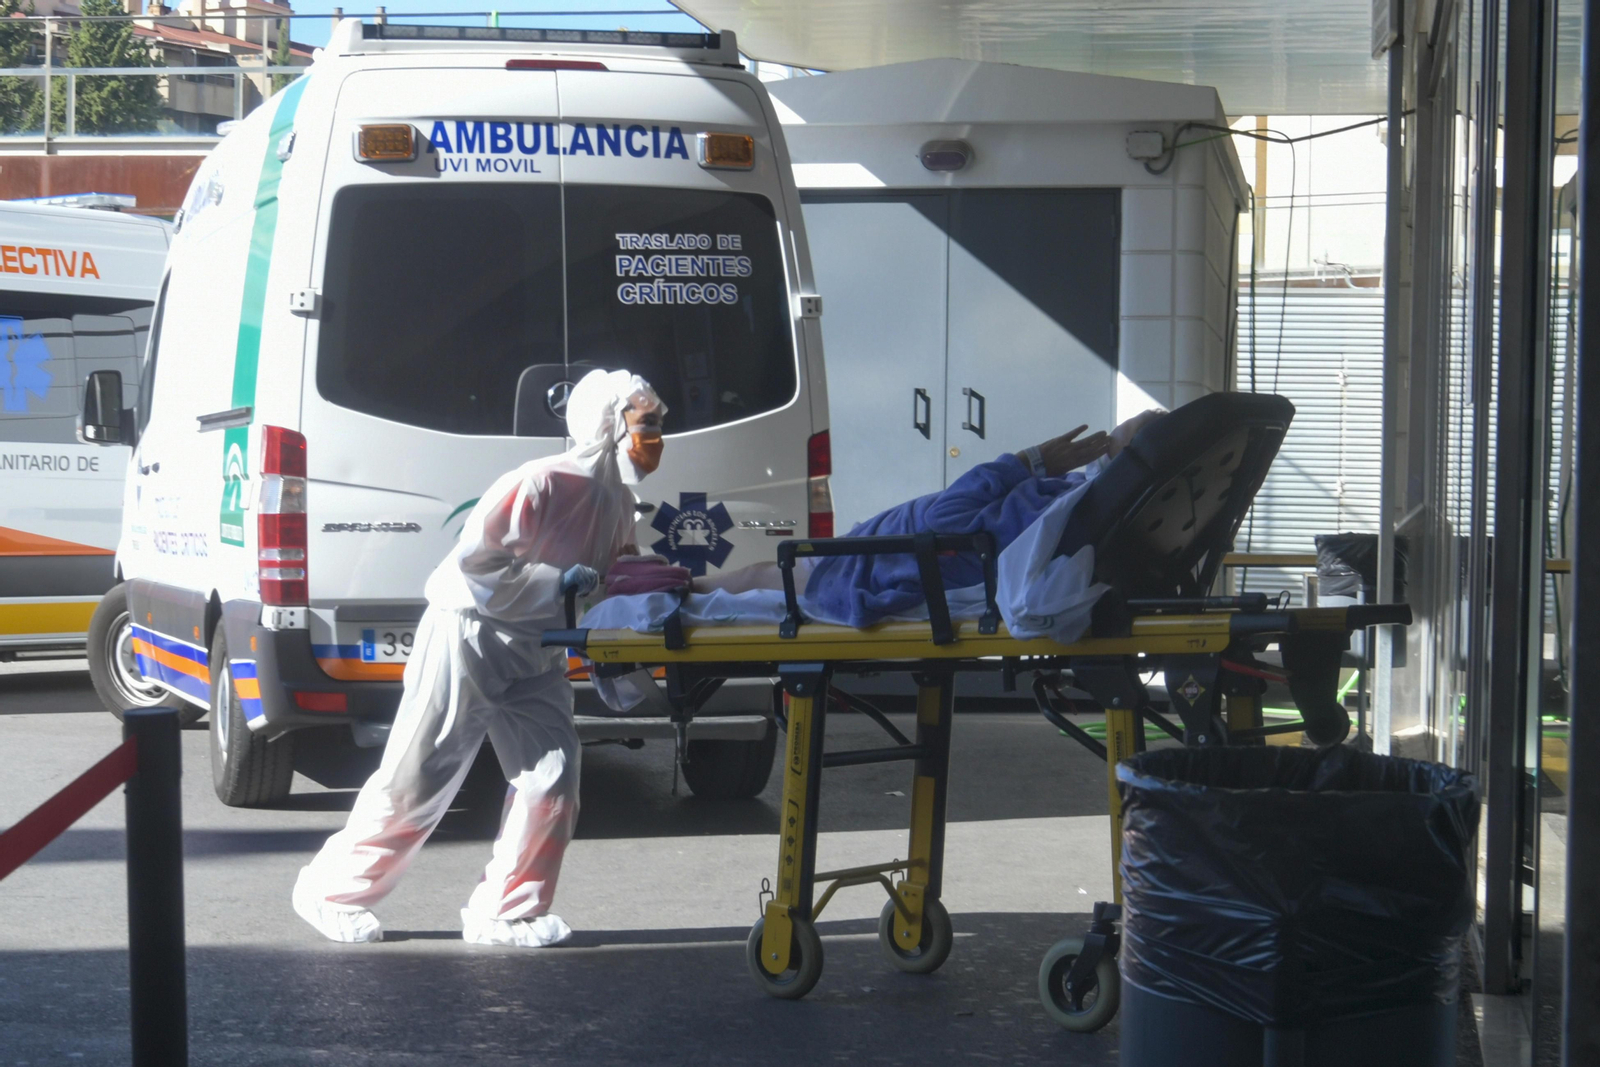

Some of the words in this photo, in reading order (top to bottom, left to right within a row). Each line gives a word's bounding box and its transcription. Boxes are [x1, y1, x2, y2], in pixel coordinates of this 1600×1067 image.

[427, 121, 690, 160] AMBULANCIA
[435, 158, 468, 173] UVI
[476, 158, 541, 174] MOVIL
[615, 233, 712, 250] TRASLADO
[717, 234, 742, 250] DE
[0, 245, 101, 279] ECTIVA
[615, 255, 752, 277] PACIENTES
[617, 278, 739, 304] CRÍTICOS
[0, 454, 70, 471] NITARIO
[77, 456, 99, 472] DE
